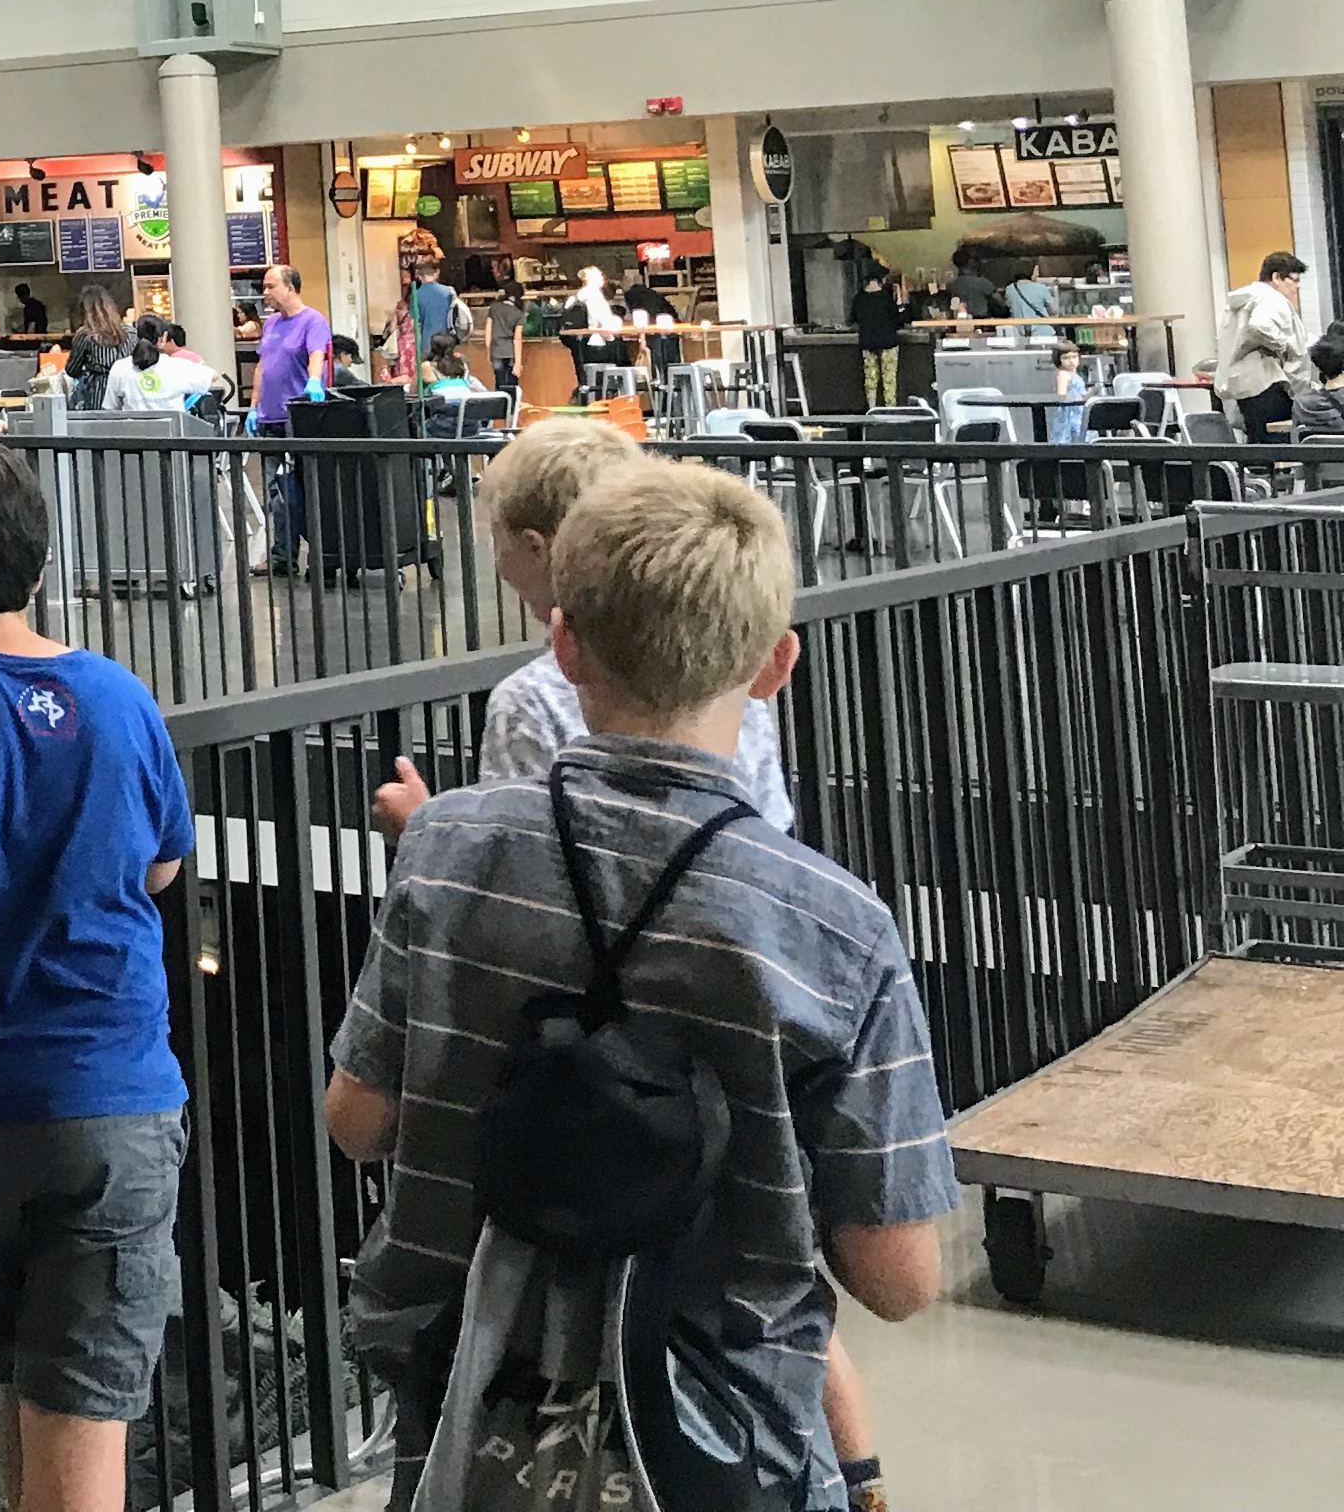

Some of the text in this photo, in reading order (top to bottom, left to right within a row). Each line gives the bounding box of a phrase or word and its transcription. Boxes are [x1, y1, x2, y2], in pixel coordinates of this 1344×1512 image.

[1020, 127, 1120, 158] KABA
[462, 147, 579, 180] SUBWAY
[3, 179, 120, 214] MEAT
[134, 209, 169, 222] PREMIE
